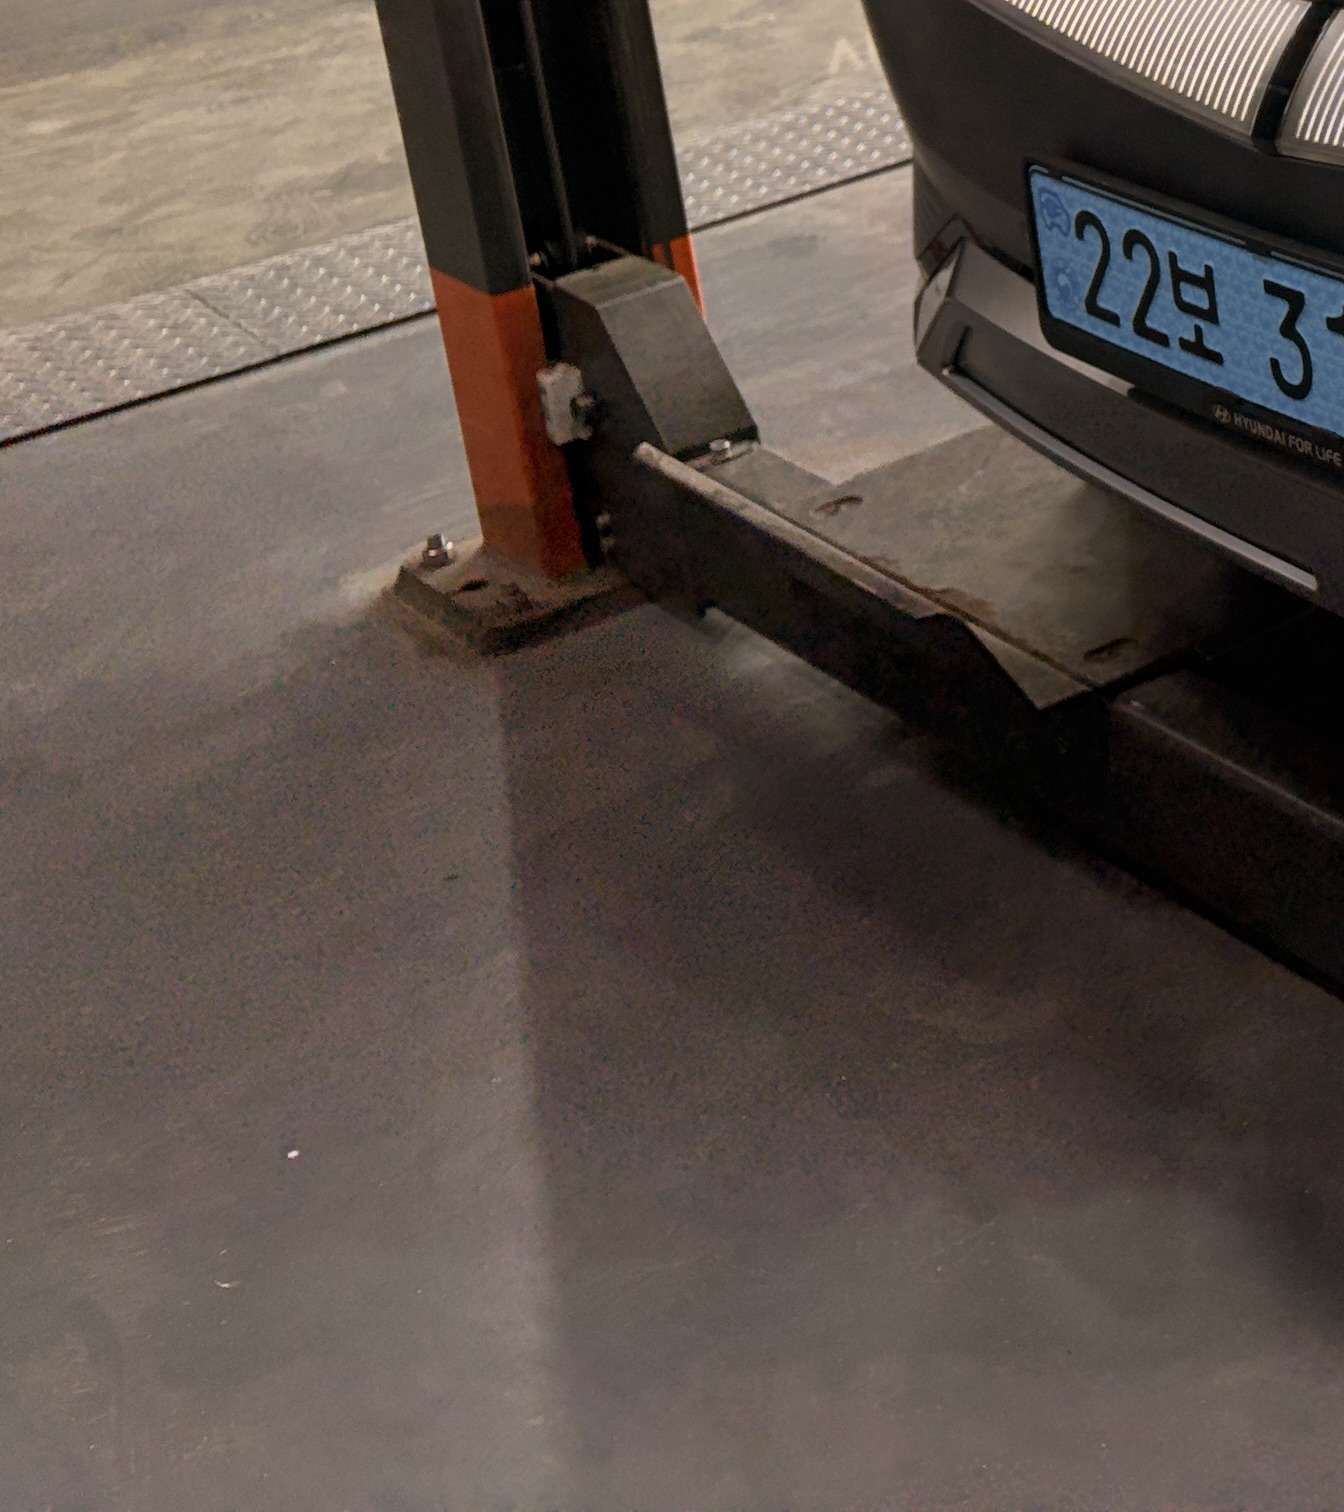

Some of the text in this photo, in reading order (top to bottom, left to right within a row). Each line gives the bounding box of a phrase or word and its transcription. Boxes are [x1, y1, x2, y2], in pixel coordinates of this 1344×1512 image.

[1074, 209, 1224, 366] 22보
[1233, 412, 1342, 467] HYUNDAI FOR LIFE
